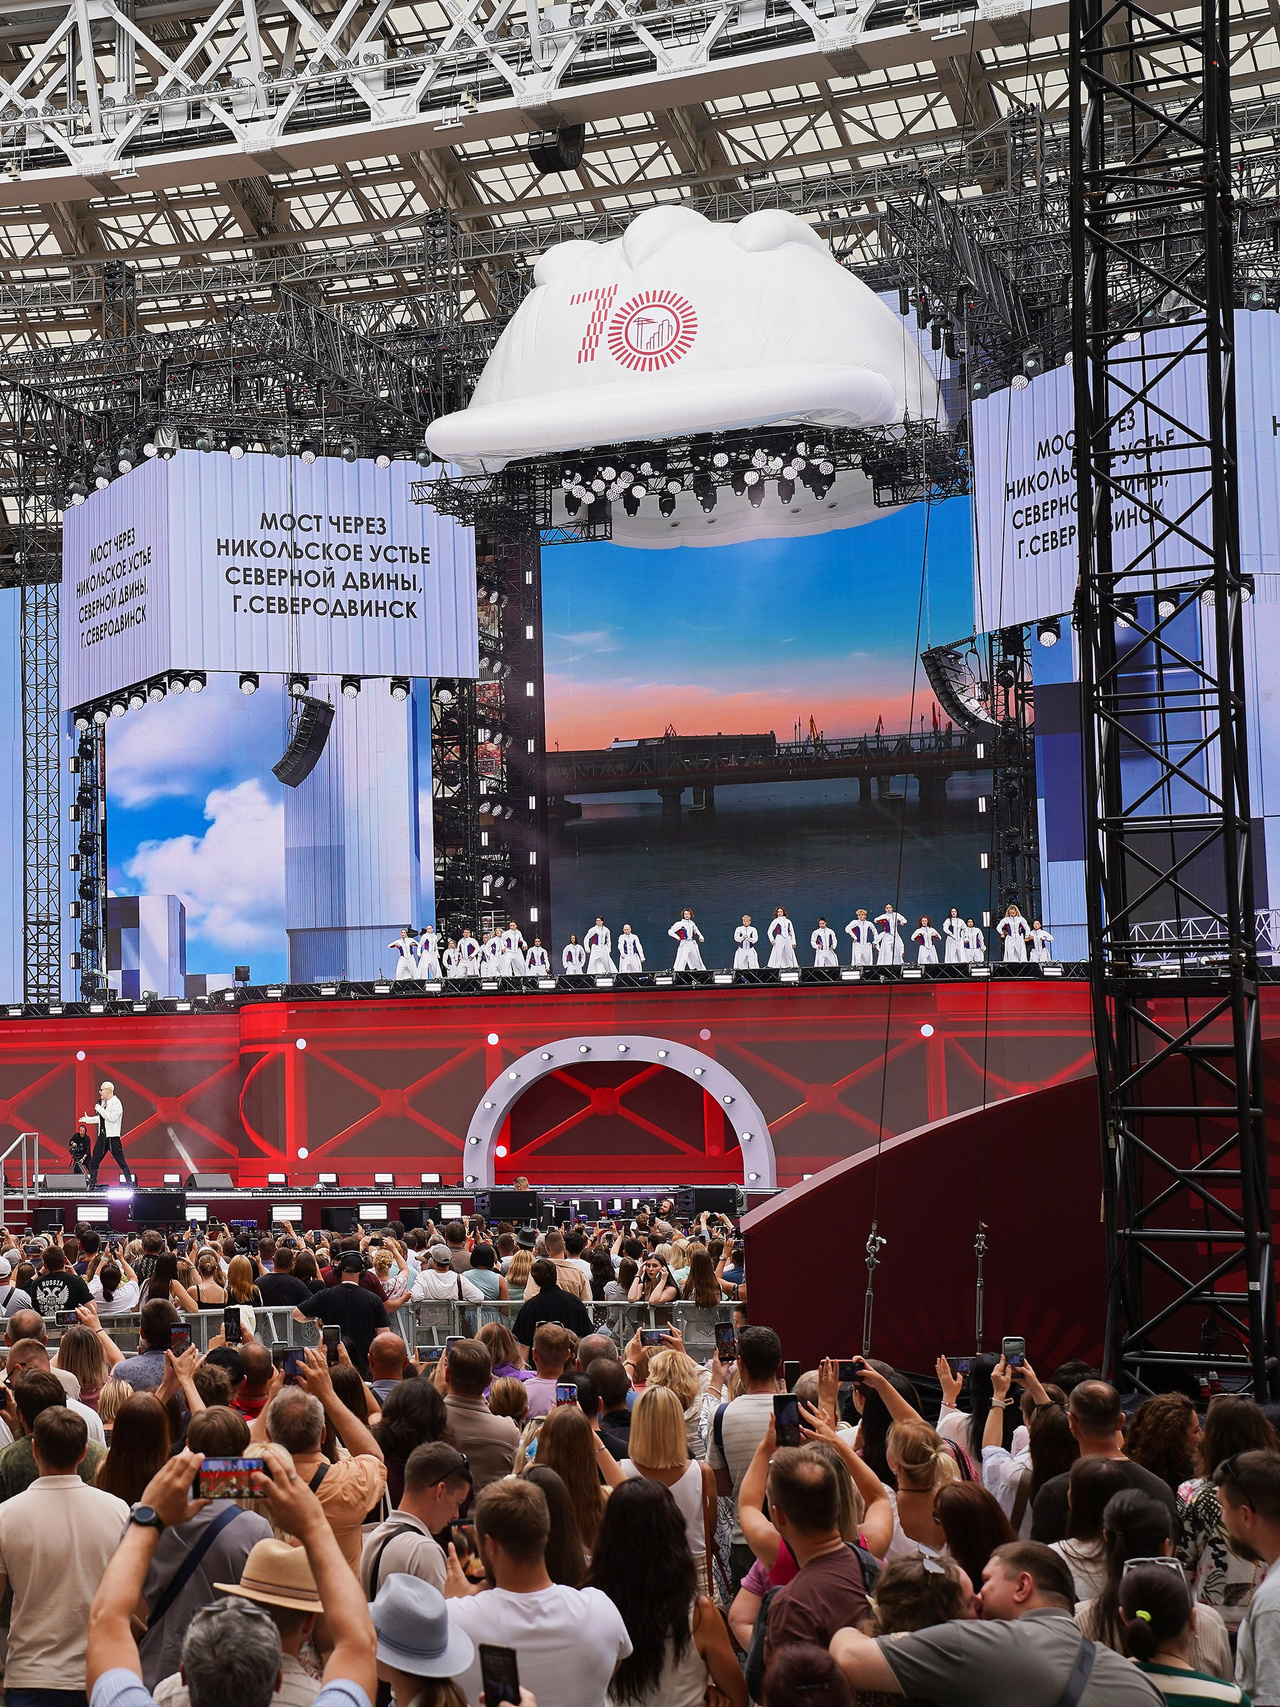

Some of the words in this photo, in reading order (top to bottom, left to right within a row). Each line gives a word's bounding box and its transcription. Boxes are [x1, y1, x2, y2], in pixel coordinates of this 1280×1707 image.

[1036, 429, 1078, 461] МОС
[259, 512, 322, 533] МОСТ
[329, 515, 387, 536] ЧЕРЕЗ
[1012, 491, 1080, 530] СЕВЕРНО
[90, 539, 112, 566] МОСТ
[114, 527, 136, 553] ЧЕРЕЗ
[217, 538, 363, 562] НИКОЛЬСКОЕ
[369, 544, 431, 565] УСТЬЕ
[76, 559, 127, 600] НИКОЛЬСКОЕ
[128, 546, 152, 574] УСТЬЕ
[225, 566, 335, 589] СЕВЕРНОЙ
[342, 571, 424, 594] ДВИНЫ,
[78, 587, 117, 624] СЕВЕРНОЙ
[118, 576, 149, 609] ДВИНЫ,
[233, 595, 418, 619] Г.СЕВЕРОДВИНСК
[81, 604, 147, 650] Г.СЕВЕРОДВИНСК
